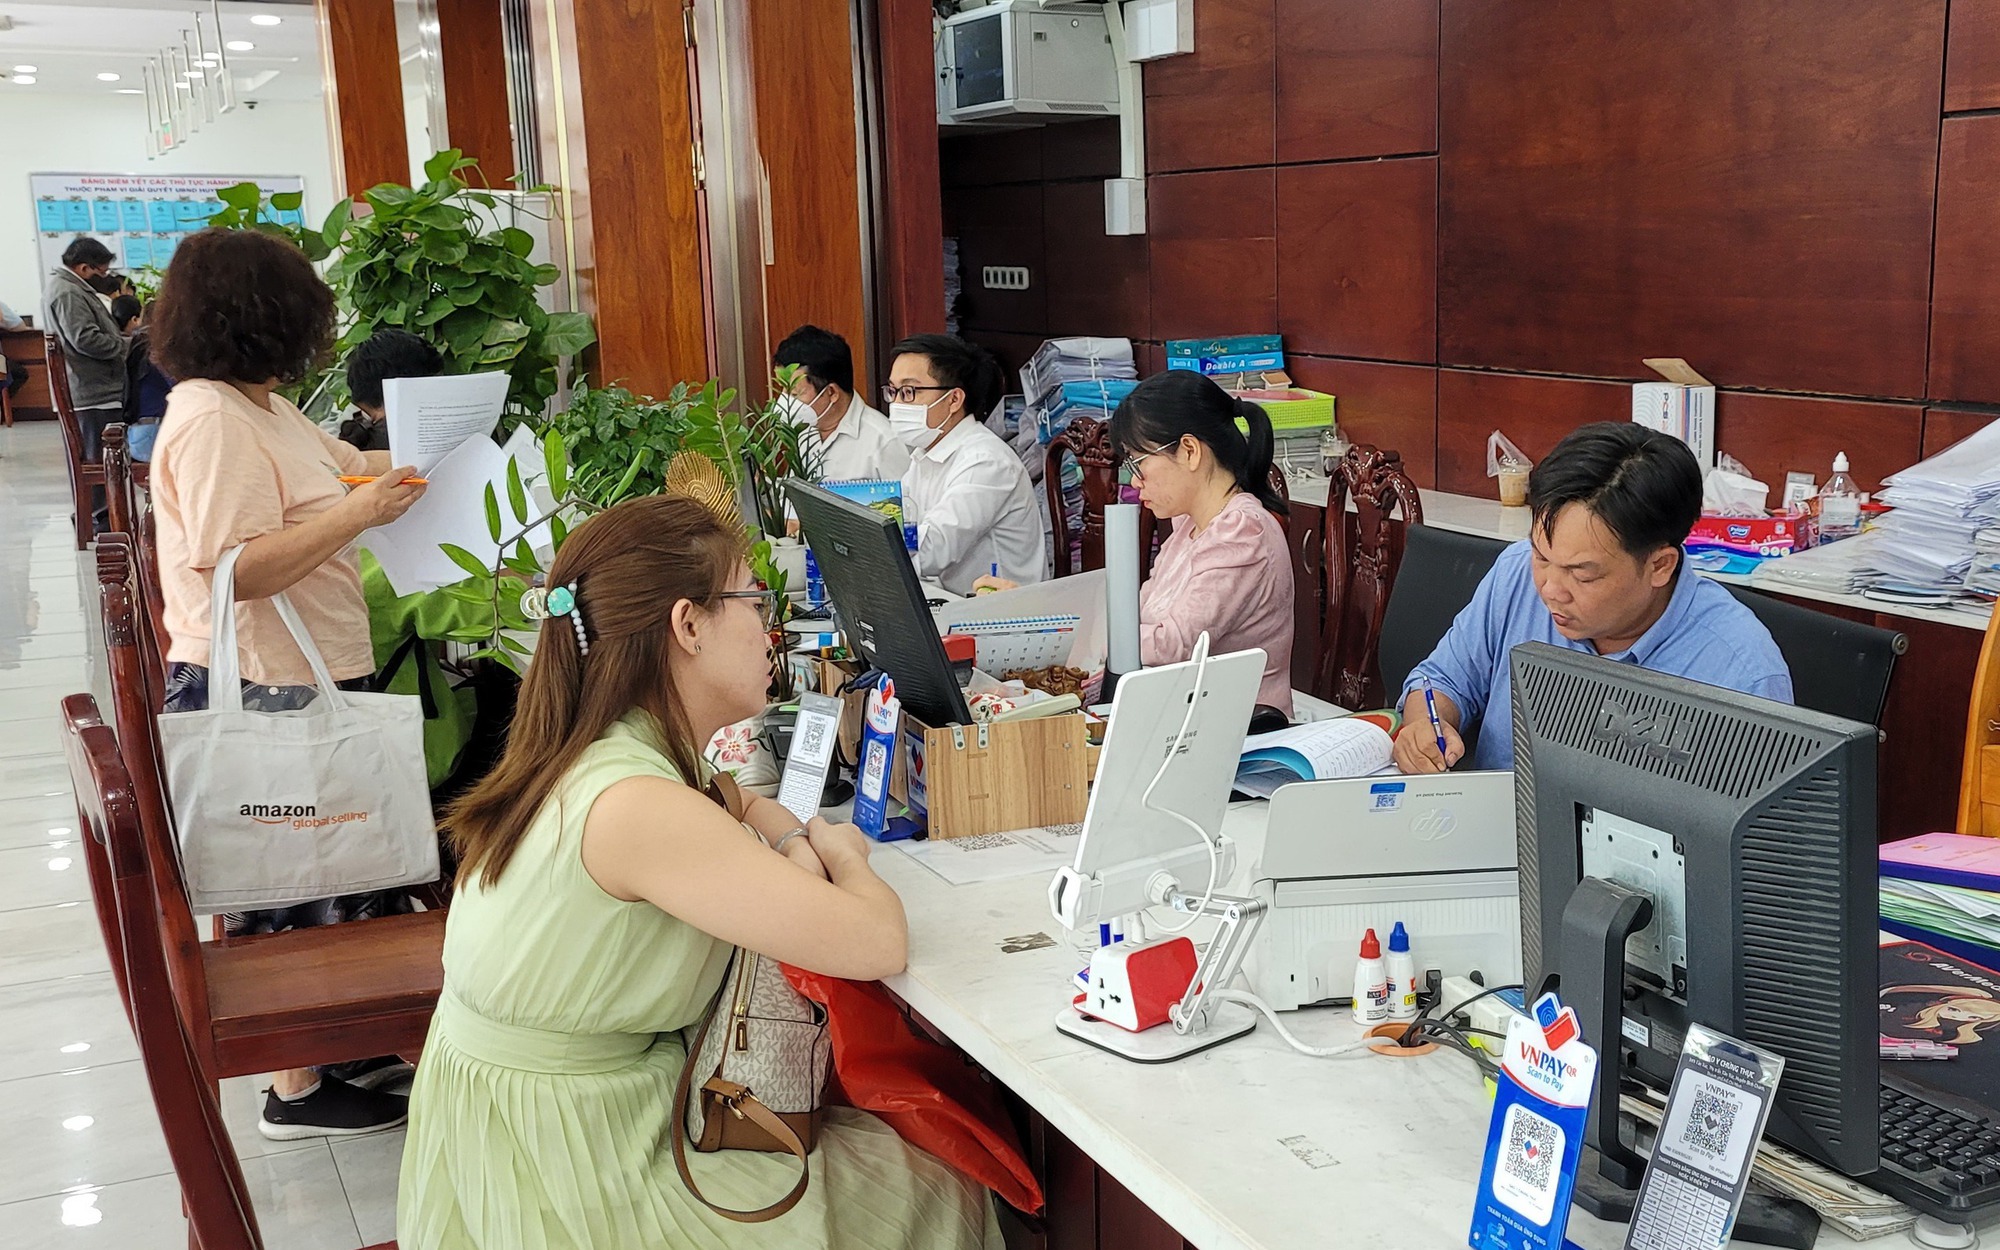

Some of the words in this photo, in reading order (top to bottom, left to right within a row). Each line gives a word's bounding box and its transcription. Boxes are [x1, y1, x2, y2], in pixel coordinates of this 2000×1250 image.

[1205, 361, 1236, 371] Double
[1165, 730, 1198, 743] SAMUNG
[240, 804, 316, 817] amazon
[293, 816, 330, 830] global
[331, 811, 368, 823] selling
[1527, 1065, 1543, 1080] Scan
[1543, 1074, 1550, 1084] to
[1551, 1078, 1564, 1092] Pay
[1689, 1144, 1700, 1153] Scan
[1705, 1151, 1715, 1161] Pay
